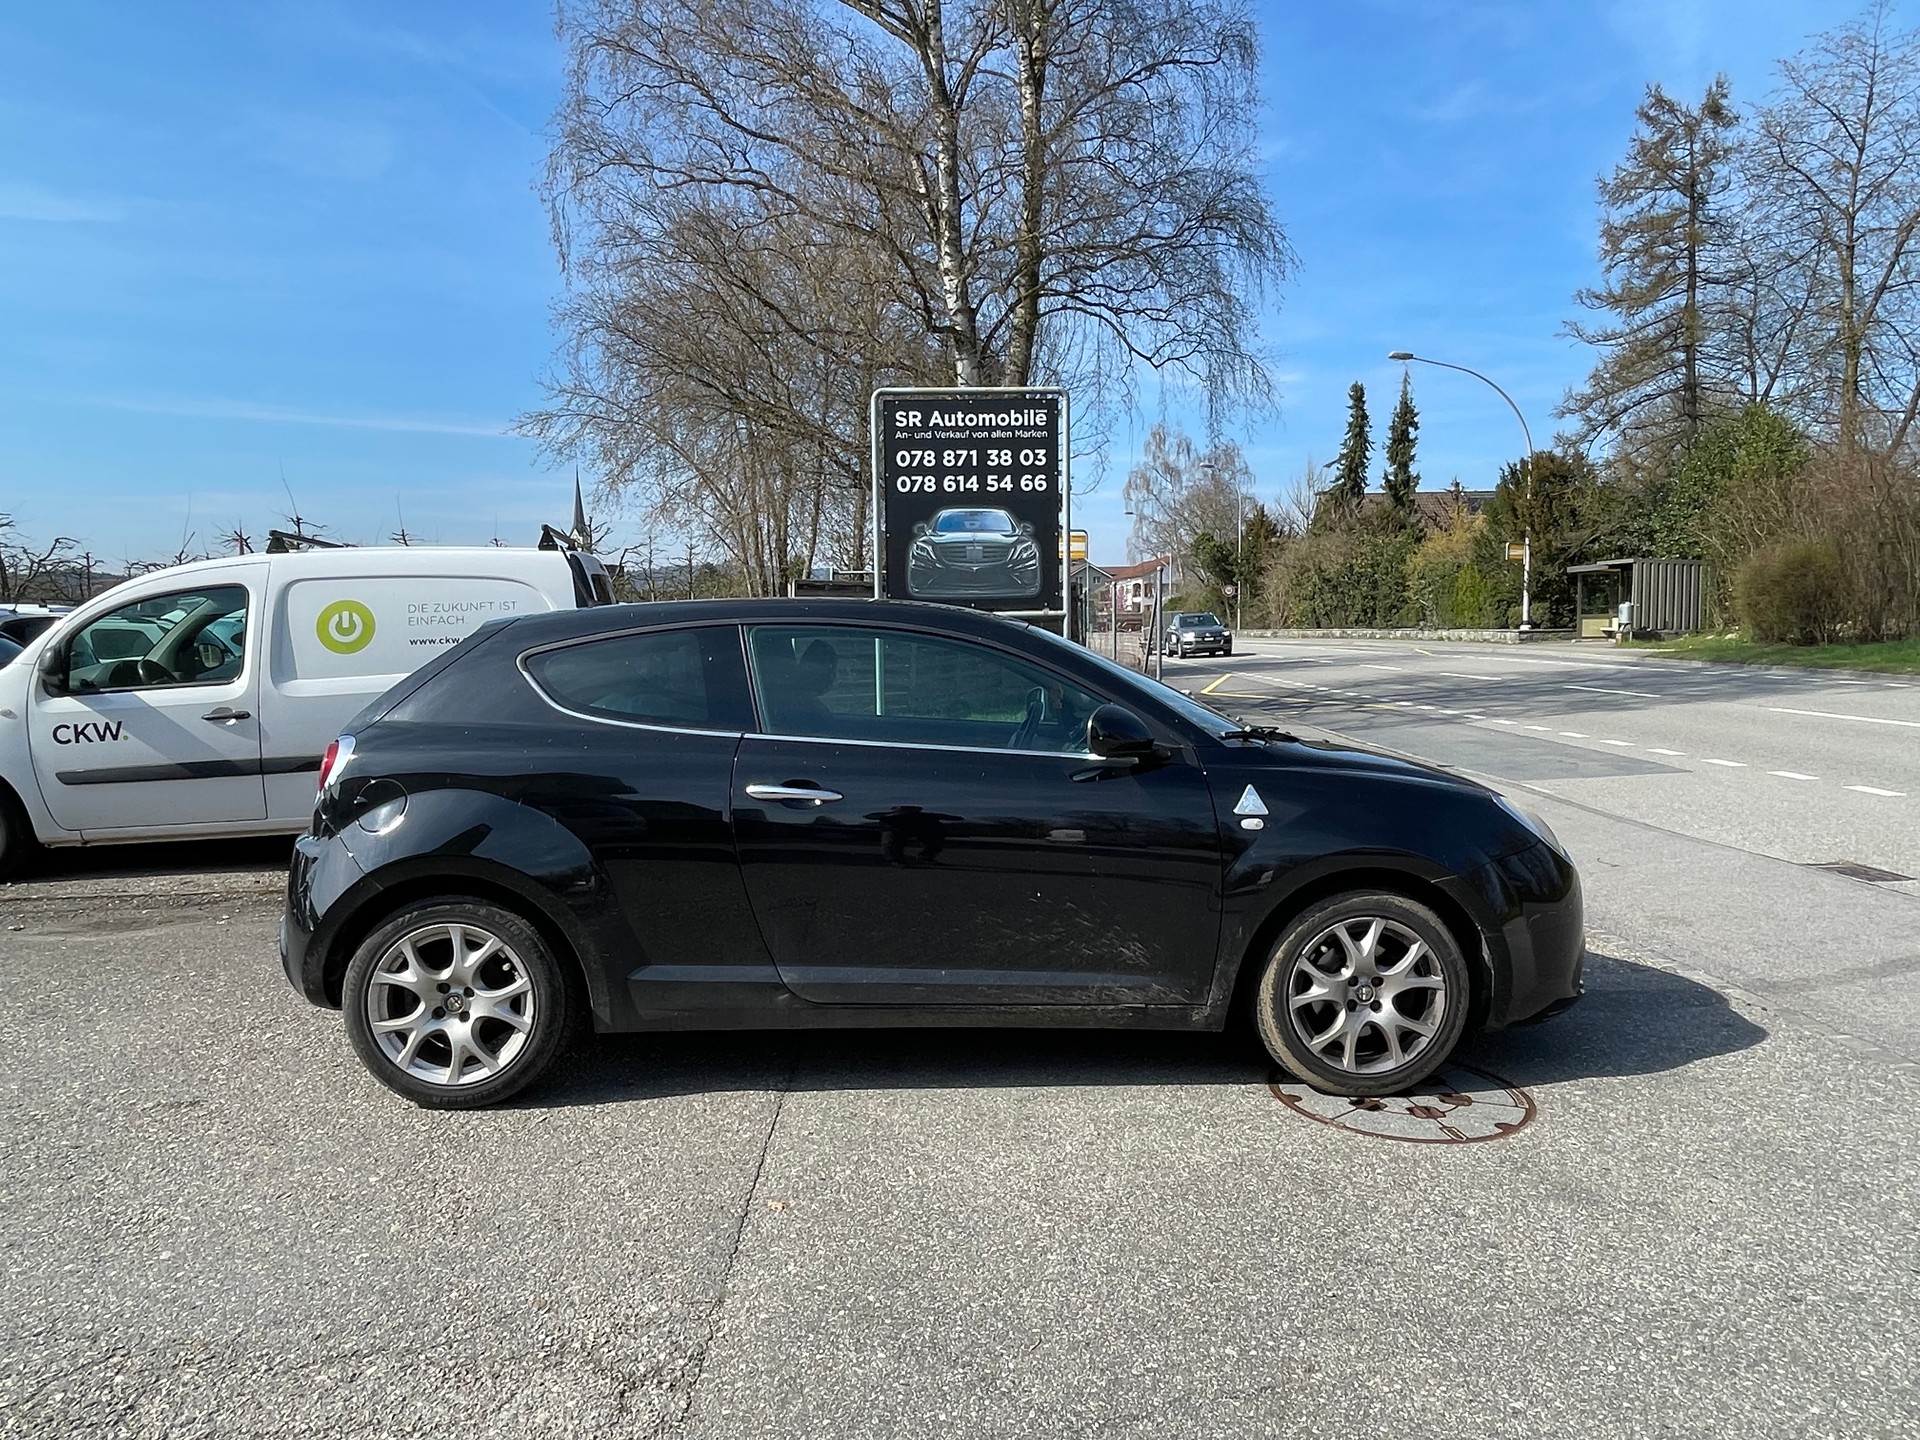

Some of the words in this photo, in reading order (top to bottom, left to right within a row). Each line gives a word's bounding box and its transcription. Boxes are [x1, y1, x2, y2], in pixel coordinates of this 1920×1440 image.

[895, 411, 922, 427] SR
[895, 431, 912, 439] An-
[914, 431, 932, 439] und
[934, 430, 969, 439] Verkauf
[972, 431, 988, 439] von
[991, 430, 1012, 438] allen
[1015, 430, 1048, 438] Marken
[896, 450, 936, 467] 078
[943, 450, 978, 466] 871
[987, 450, 1012, 466] 38
[1019, 449, 1047, 465] 03
[897, 475, 936, 492] 078
[943, 475, 979, 491] 614
[986, 475, 1013, 491] 54
[1020, 475, 1047, 491] 66
[408, 604, 428, 614] DIE
[433, 602, 494, 612] ZUKUNFT
[499, 601, 517, 611] IST
